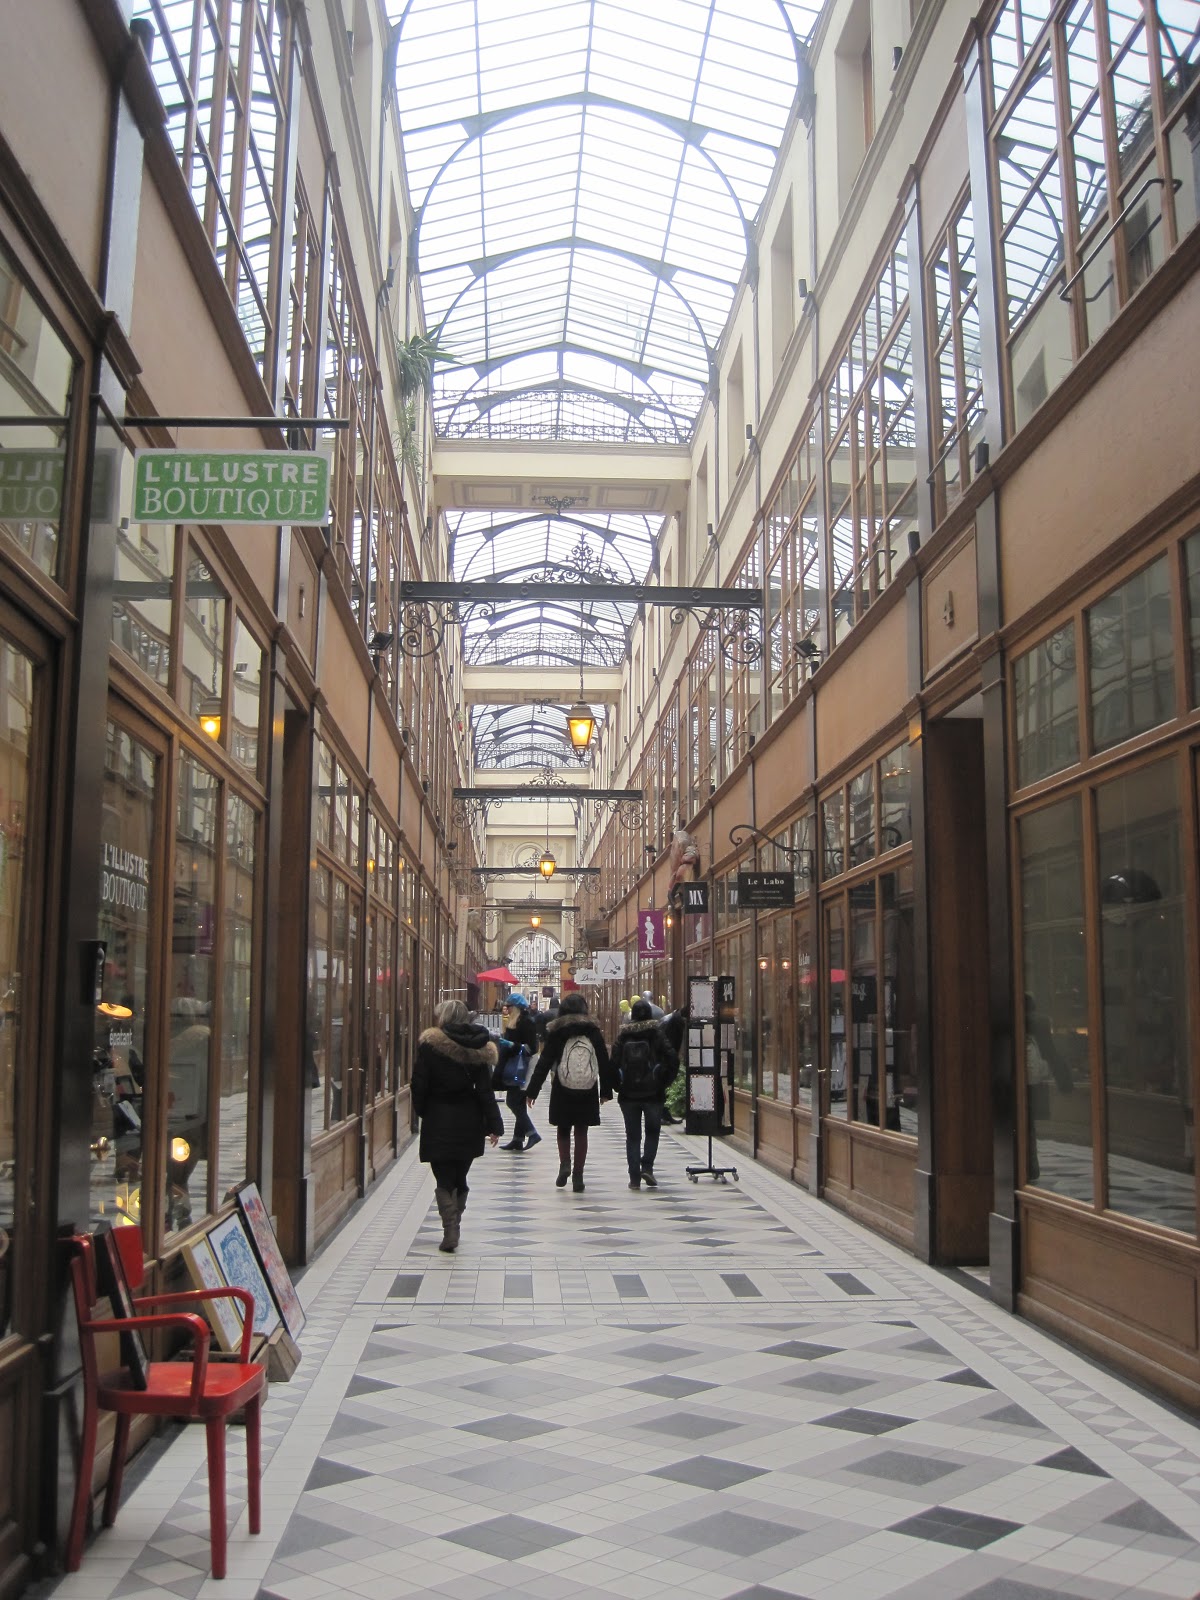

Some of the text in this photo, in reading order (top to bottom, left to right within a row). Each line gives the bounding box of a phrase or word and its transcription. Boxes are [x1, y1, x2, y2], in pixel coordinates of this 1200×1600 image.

[145, 461, 319, 484] L'ILLUSTRE
[141, 487, 318, 518] BOUTIQUE
[104, 843, 149, 881] L'ILLUSTRE
[102, 871, 147, 911] BOUTIQUE
[688, 889, 704, 905] MX
[109, 1028, 133, 1050] épatant
